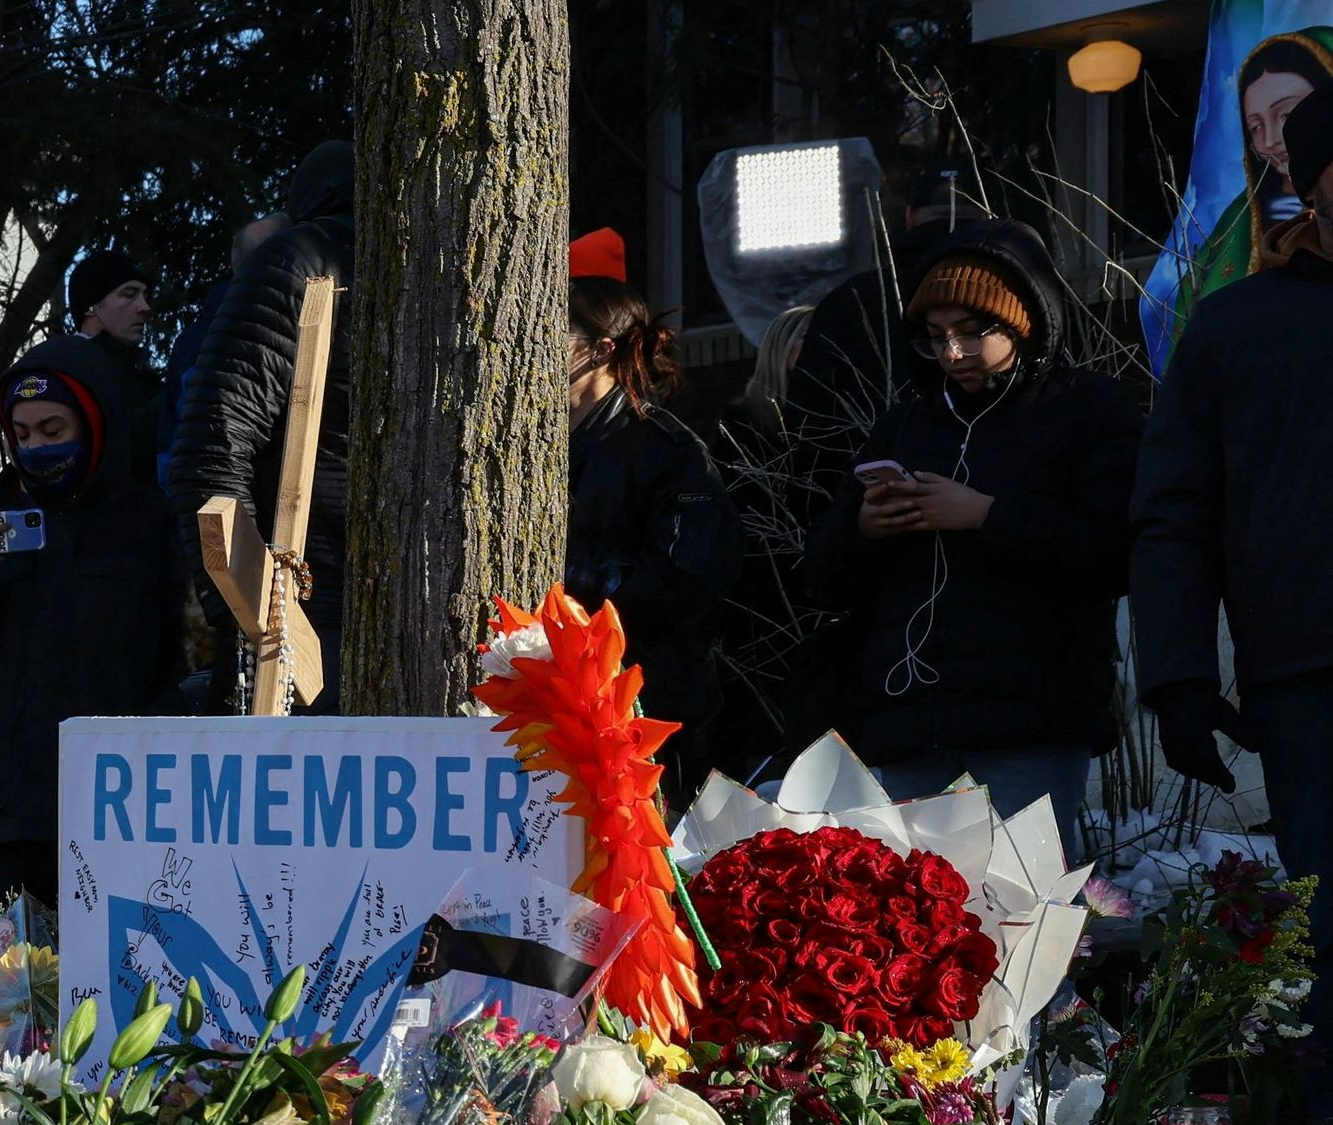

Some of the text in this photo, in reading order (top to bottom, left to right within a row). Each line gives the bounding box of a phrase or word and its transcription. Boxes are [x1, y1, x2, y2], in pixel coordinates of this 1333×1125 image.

[93, 753, 530, 853] REMEMBER
[68, 840, 83, 862] REST
[82, 864, 96, 885] EASY
[162, 848, 193, 895] We
[147, 880, 192, 920] Got
[238, 893, 250, 926] will
[263, 893, 273, 911] be
[520, 896, 537, 937] peace
[206, 985, 232, 1009] YOU
[303, 985, 318, 1005] will
[313, 984, 333, 1013] across
[203, 1008, 218, 1027] BE
[352, 1010, 369, 1040] your
